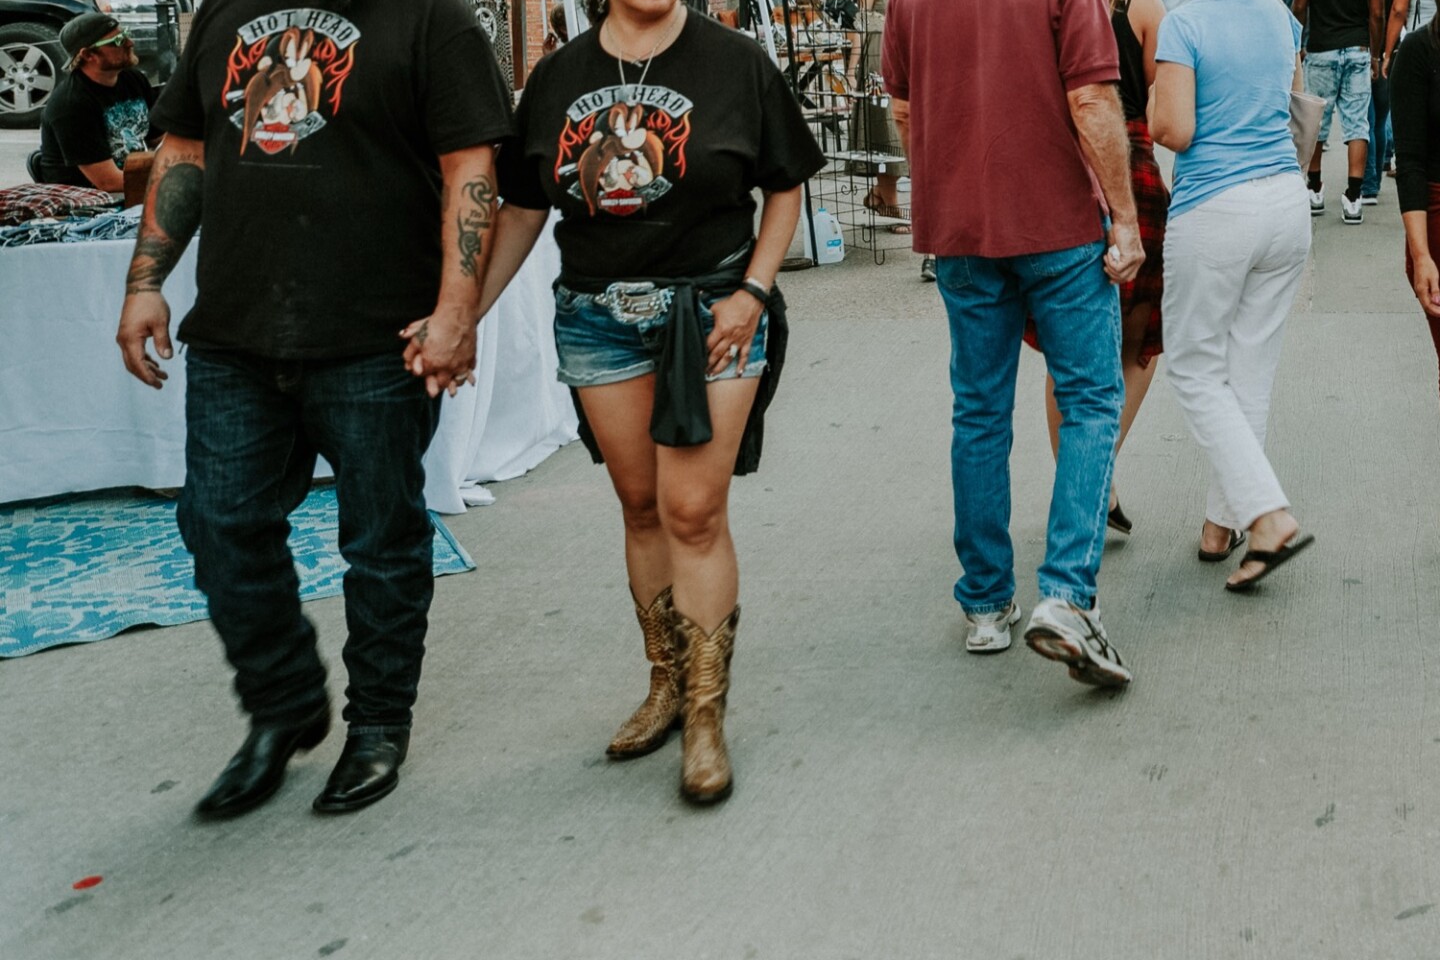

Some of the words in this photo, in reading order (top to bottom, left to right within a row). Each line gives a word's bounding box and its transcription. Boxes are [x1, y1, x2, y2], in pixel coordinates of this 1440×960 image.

[250, 11, 297, 39] HOT
[305, 11, 354, 42] HEAD
[575, 88, 620, 116] HOT
[633, 86, 685, 112] HEAD
